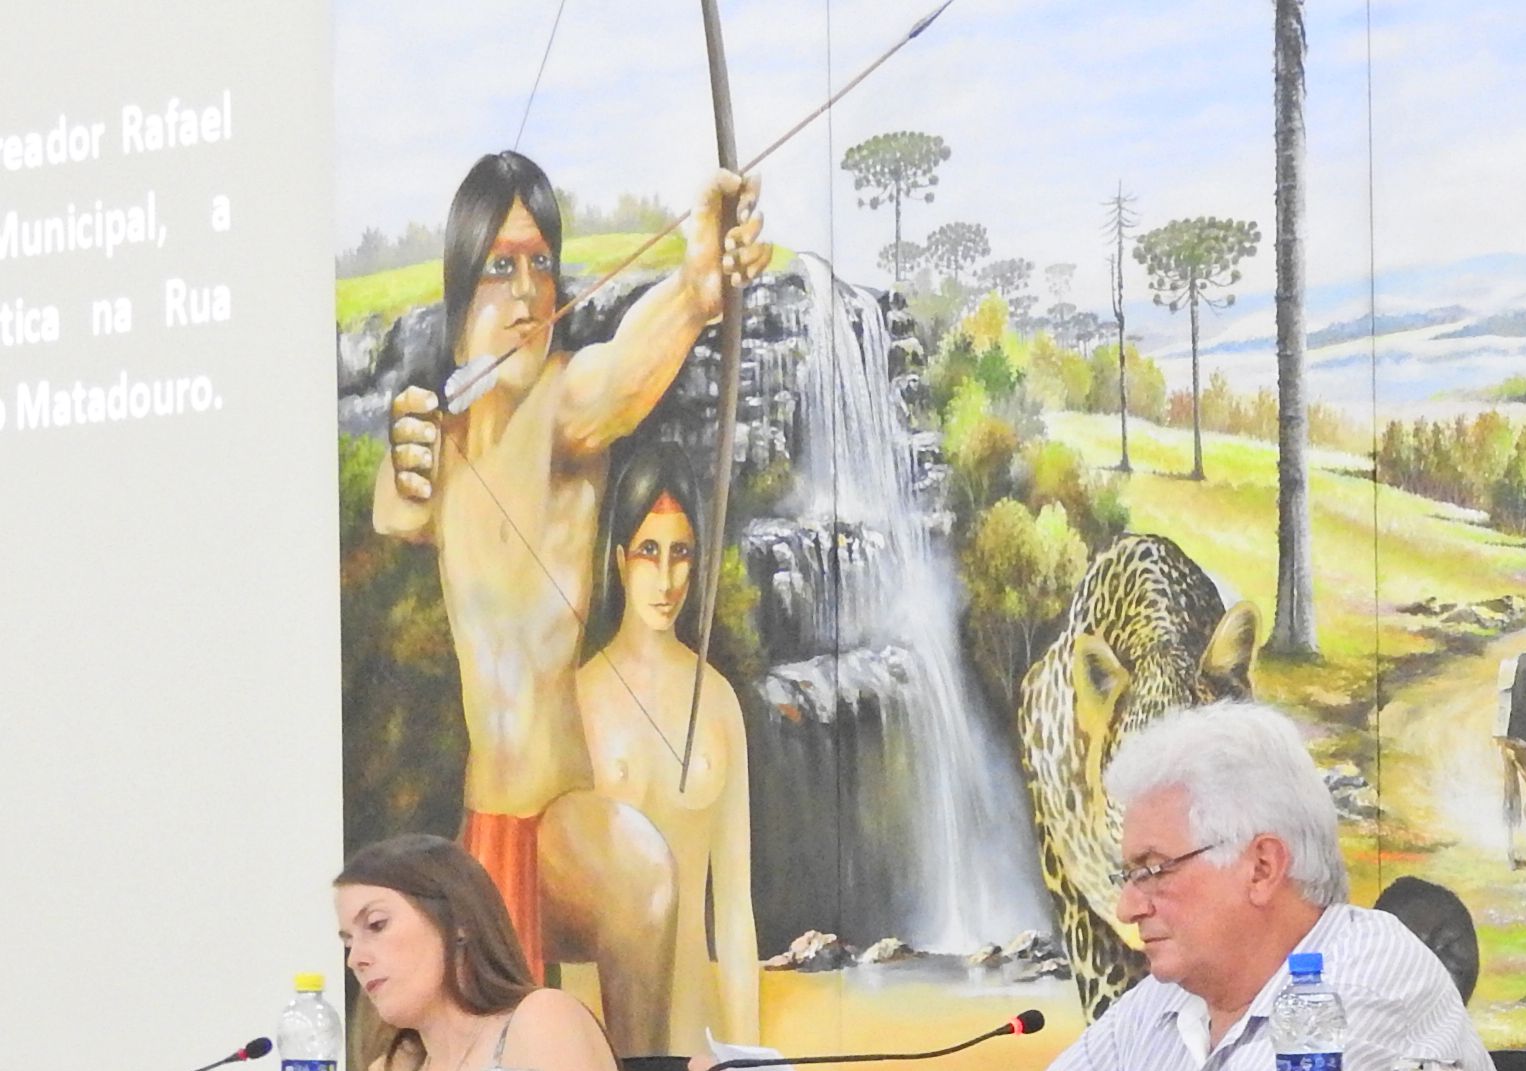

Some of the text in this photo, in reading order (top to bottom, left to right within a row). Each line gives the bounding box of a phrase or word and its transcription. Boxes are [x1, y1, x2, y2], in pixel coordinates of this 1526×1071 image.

[121, 89, 232, 155] Rafael
[211, 194, 232, 232] a
[92, 297, 132, 336] na
[164, 277, 232, 328] Rua
[16, 369, 224, 431] Matadouro.
